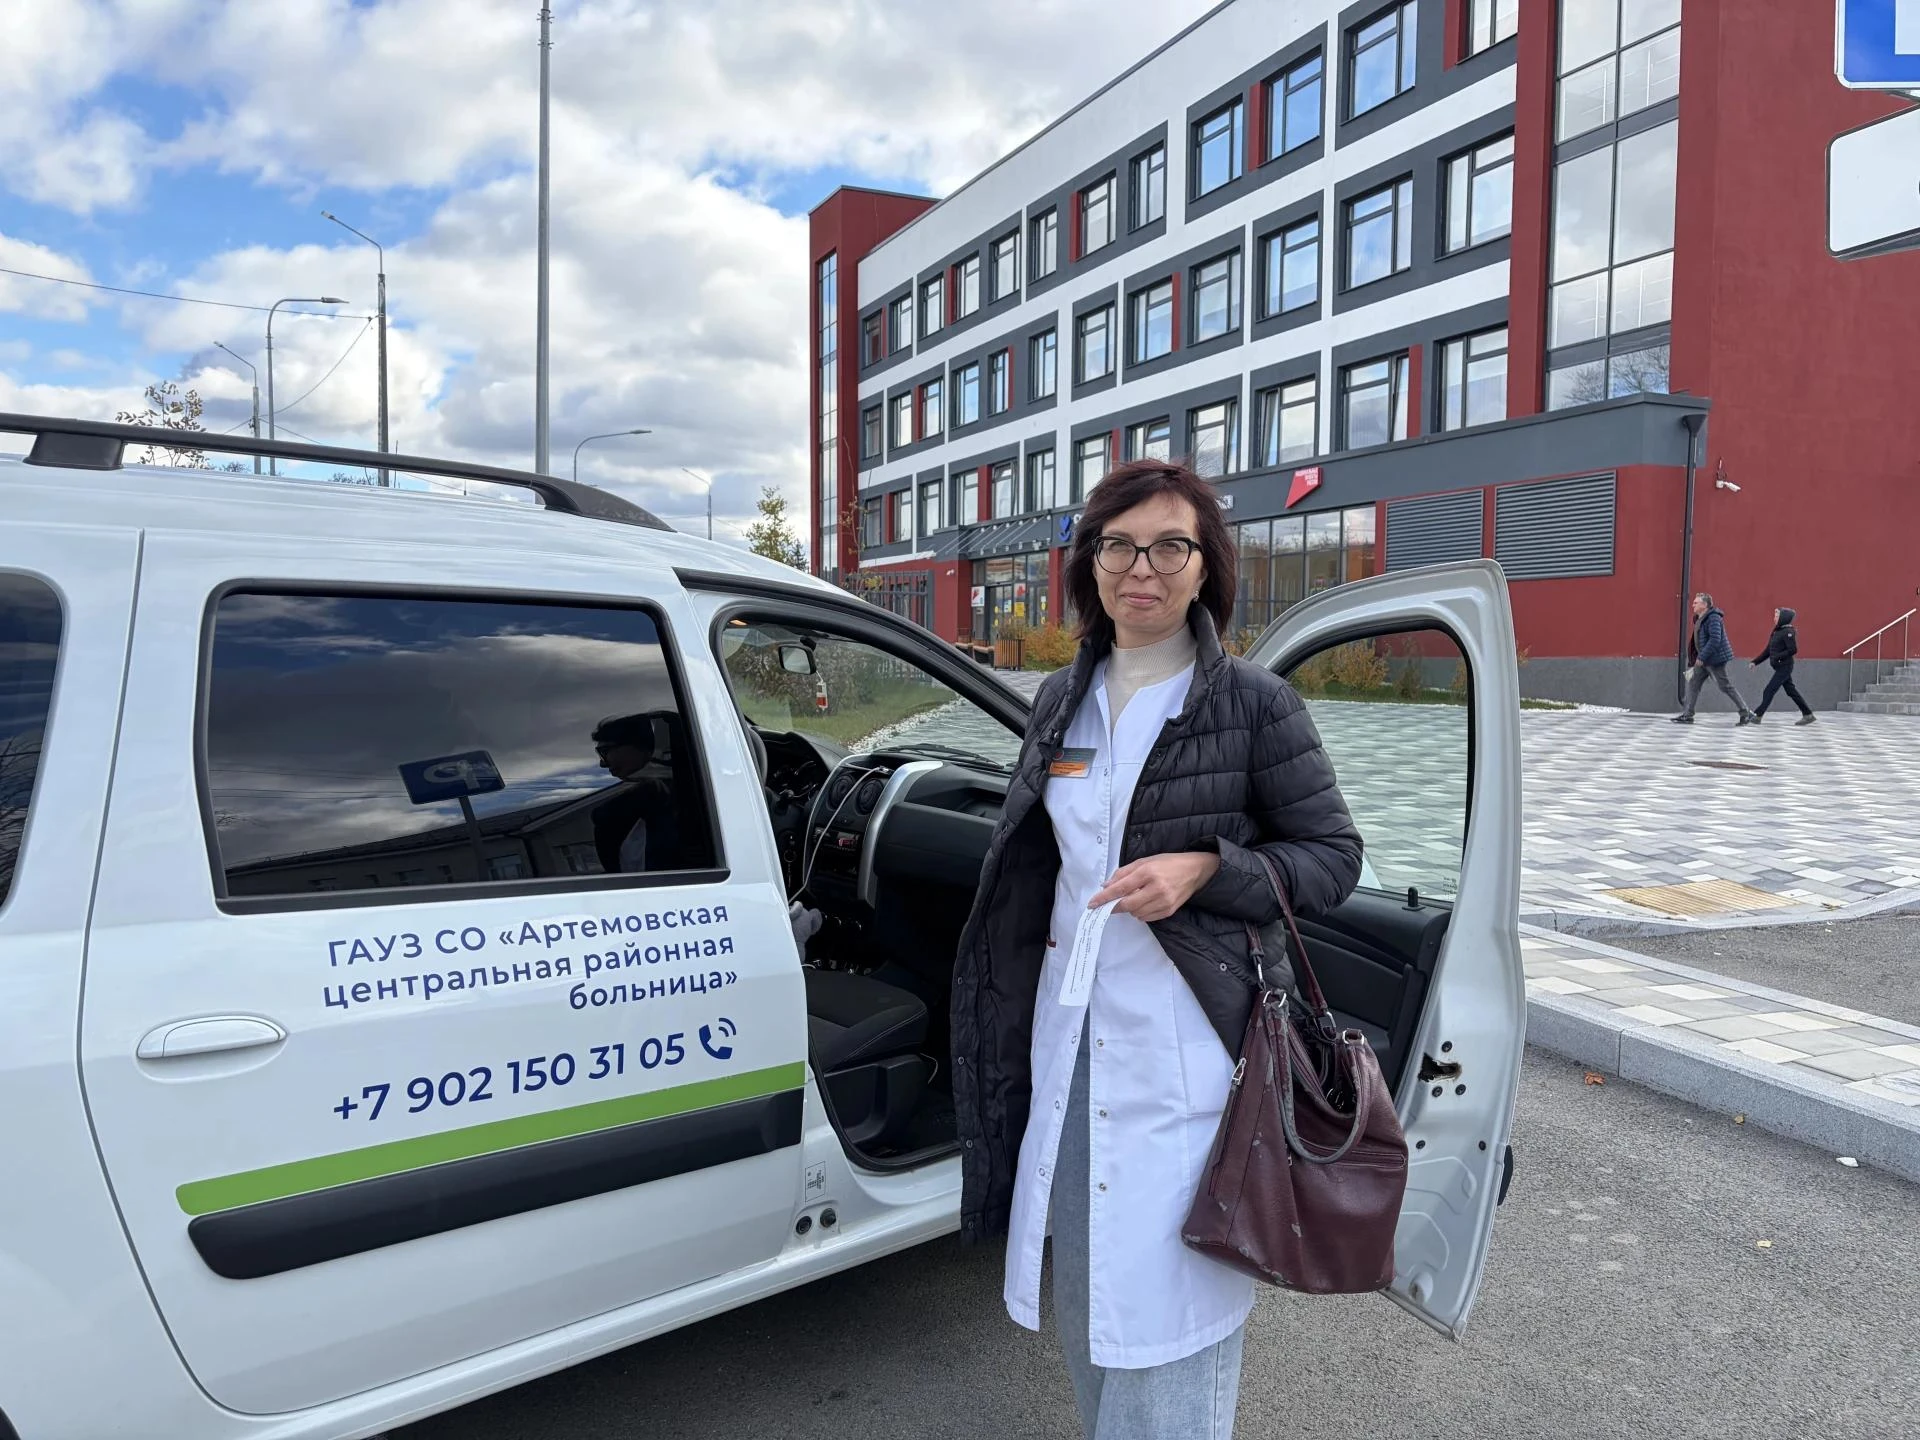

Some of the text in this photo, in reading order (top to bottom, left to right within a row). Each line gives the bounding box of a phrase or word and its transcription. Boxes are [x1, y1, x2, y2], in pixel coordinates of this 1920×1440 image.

[328, 905, 729, 967] ГАУЗ СО «Артемовская
[323, 935, 734, 1009] центральная районная
[569, 970, 738, 1010] больница»
[333, 1032, 685, 1121] +7 902 150 31 05
